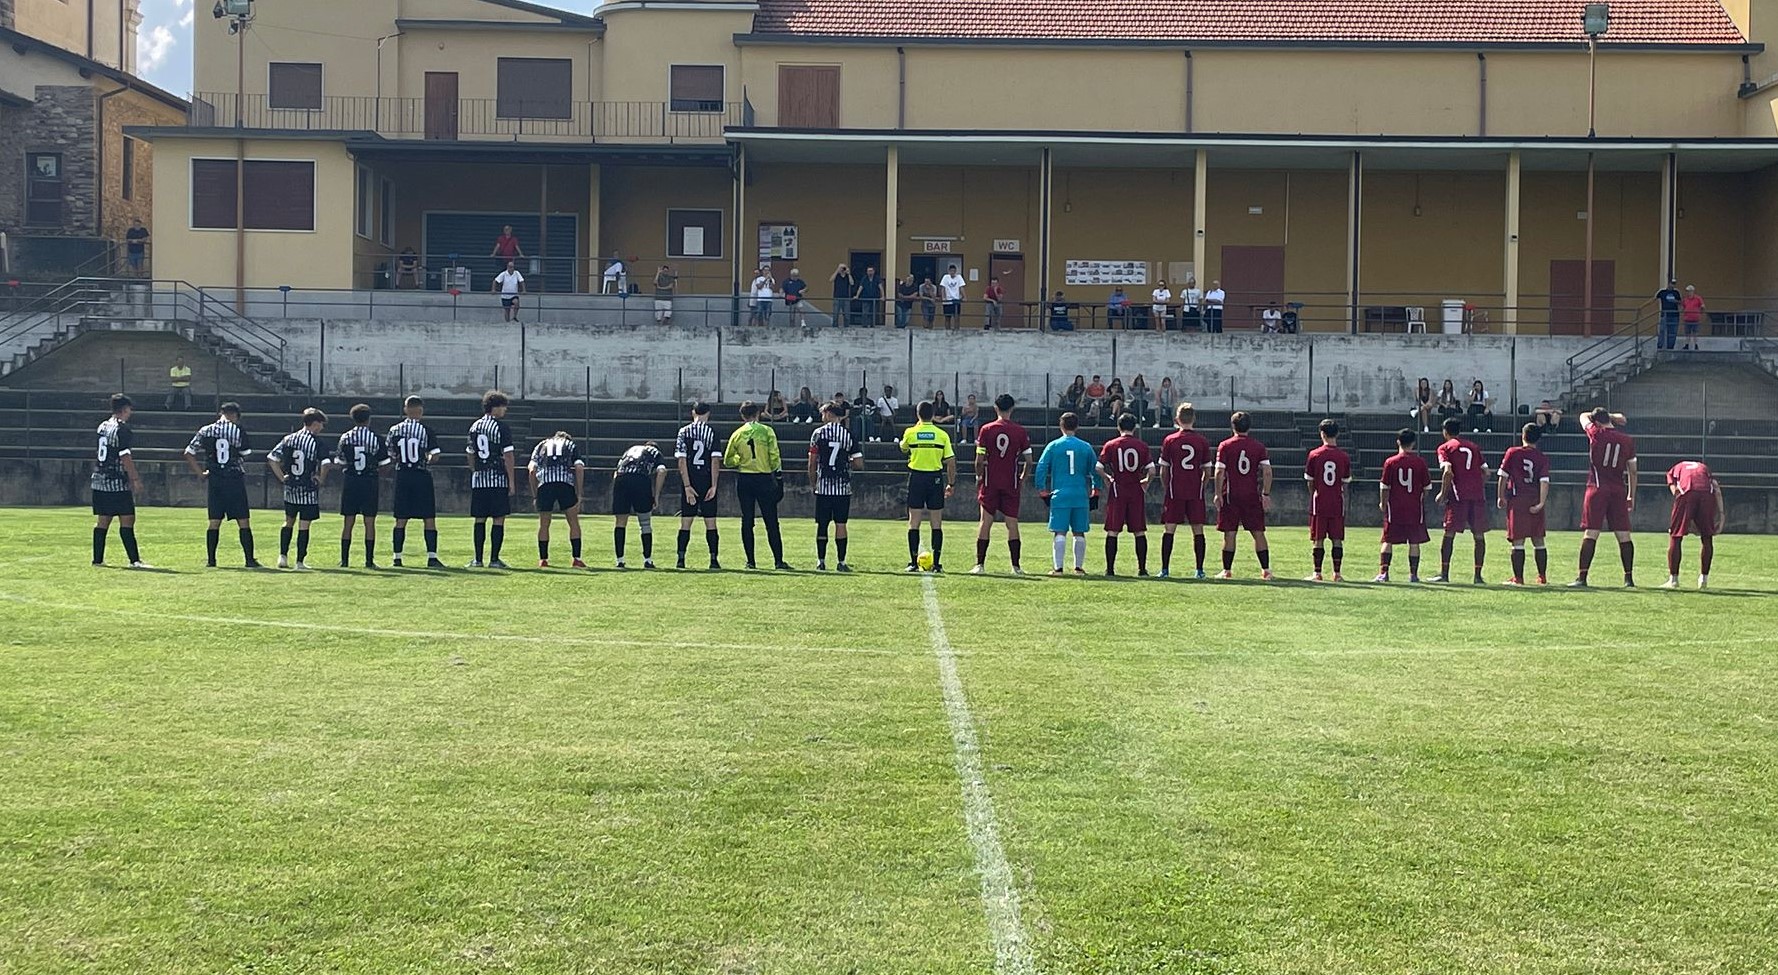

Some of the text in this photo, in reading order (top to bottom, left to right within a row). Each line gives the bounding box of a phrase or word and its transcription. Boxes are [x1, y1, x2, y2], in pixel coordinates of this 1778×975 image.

[926, 242, 949, 251] BAR
[998, 242, 1015, 250] WC
[97, 436, 108, 462] 6
[215, 438, 230, 464] 8
[398, 437, 419, 464] 10
[477, 434, 490, 459] 9
[692, 440, 705, 465] 2
[746, 438, 756, 459] 1
[828, 441, 840, 466] 7
[995, 433, 1009, 458] 9
[1181, 444, 1195, 470] 2
[1603, 443, 1621, 468] 11
[291, 450, 305, 475] 3
[354, 446, 366, 471] 5
[1066, 450, 1075, 475] 1
[1117, 447, 1139, 473] 10
[1237, 450, 1250, 475] 6
[1459, 447, 1472, 470] 7
[1523, 458, 1534, 483] 3
[1323, 461, 1337, 486] 8
[1399, 468, 1412, 493] 4
